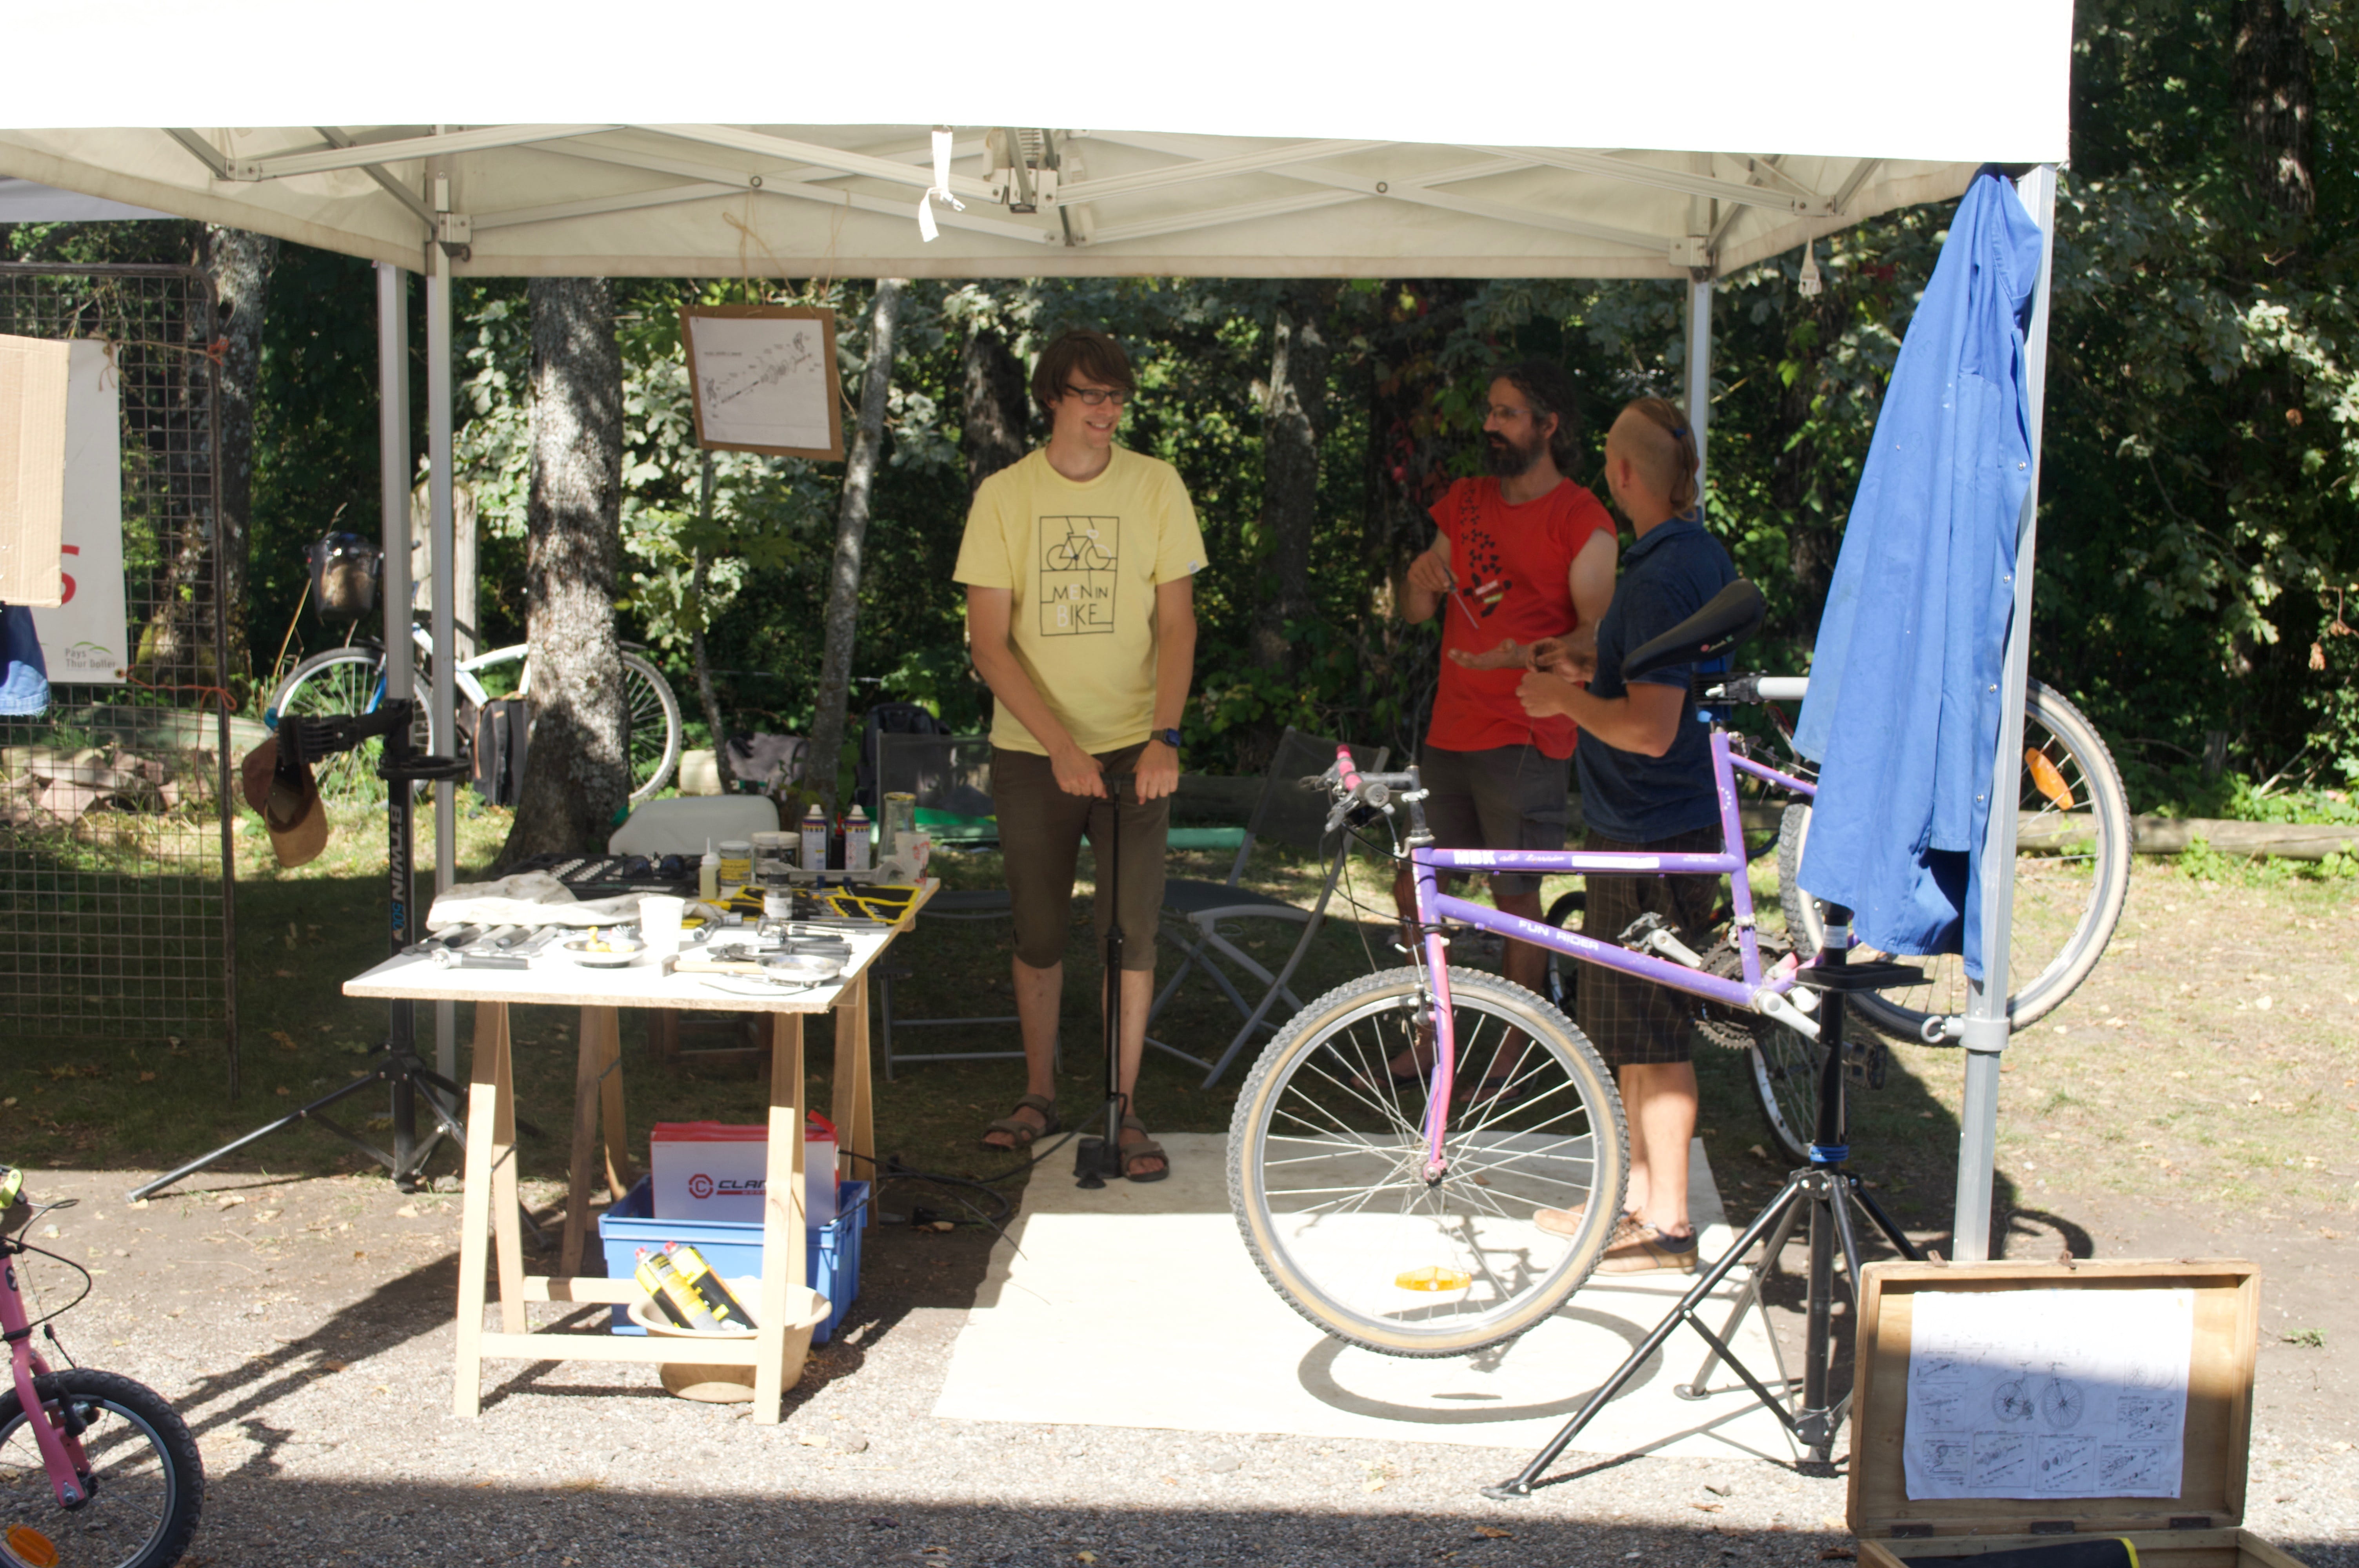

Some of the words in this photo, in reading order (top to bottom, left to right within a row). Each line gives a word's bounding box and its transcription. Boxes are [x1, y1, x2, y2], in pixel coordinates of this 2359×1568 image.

[1054, 584, 1092, 600] MEN
[1096, 587, 1108, 599] IN
[1057, 604, 1098, 627] BIKE
[65, 648, 86, 659] Pays
[65, 659, 87, 668] Thur
[90, 659, 116, 669] Doller
[1454, 850, 1497, 865] MBK
[1518, 920, 1549, 936] FUN
[1556, 931, 1599, 951] RIDER
